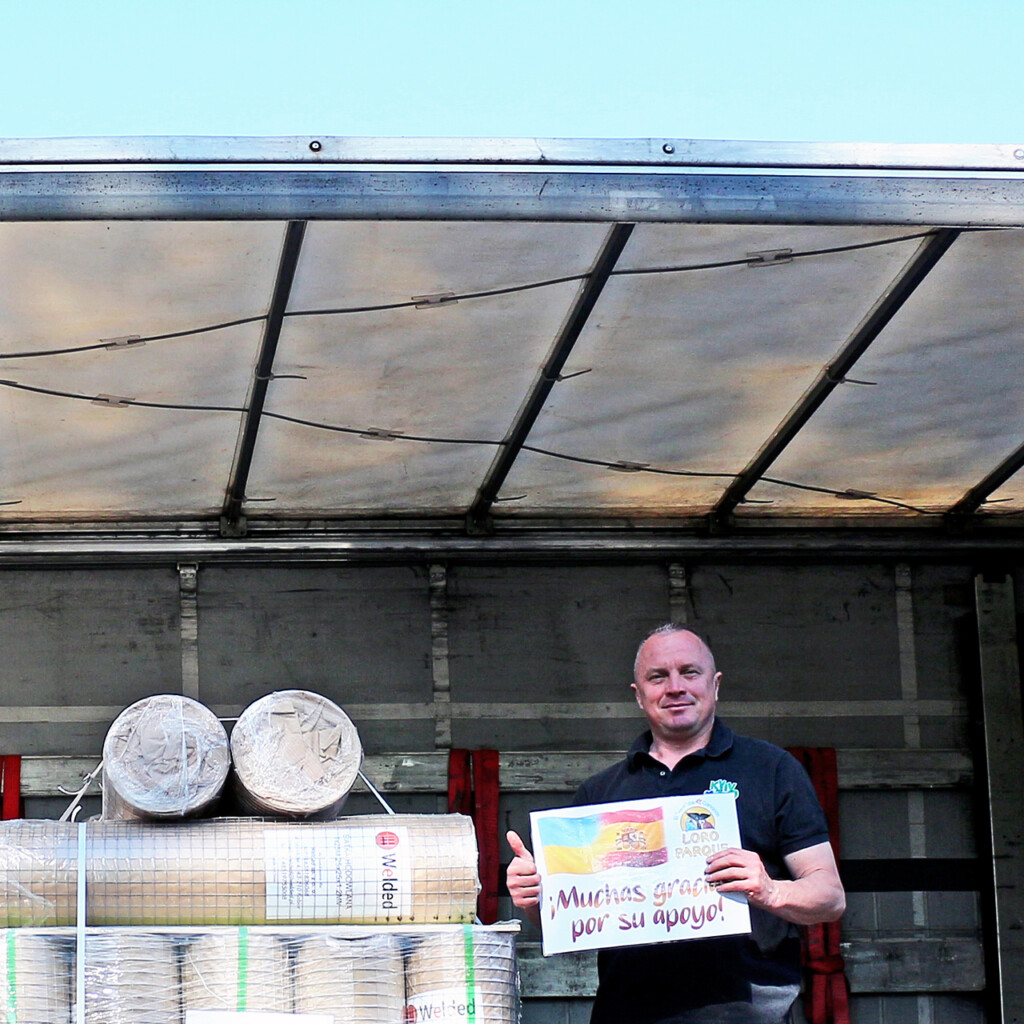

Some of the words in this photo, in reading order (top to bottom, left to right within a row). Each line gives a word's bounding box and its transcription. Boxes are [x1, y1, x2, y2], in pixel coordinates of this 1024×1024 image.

[682, 831, 719, 844] LORO
[382, 853, 398, 909] Welded
[549, 883, 646, 920] ¡Muchas
[653, 876, 716, 906] graci
[572, 913, 609, 942] por
[618, 912, 645, 930] su
[653, 895, 724, 932] apoyo!
[419, 998, 475, 1021] Welded
